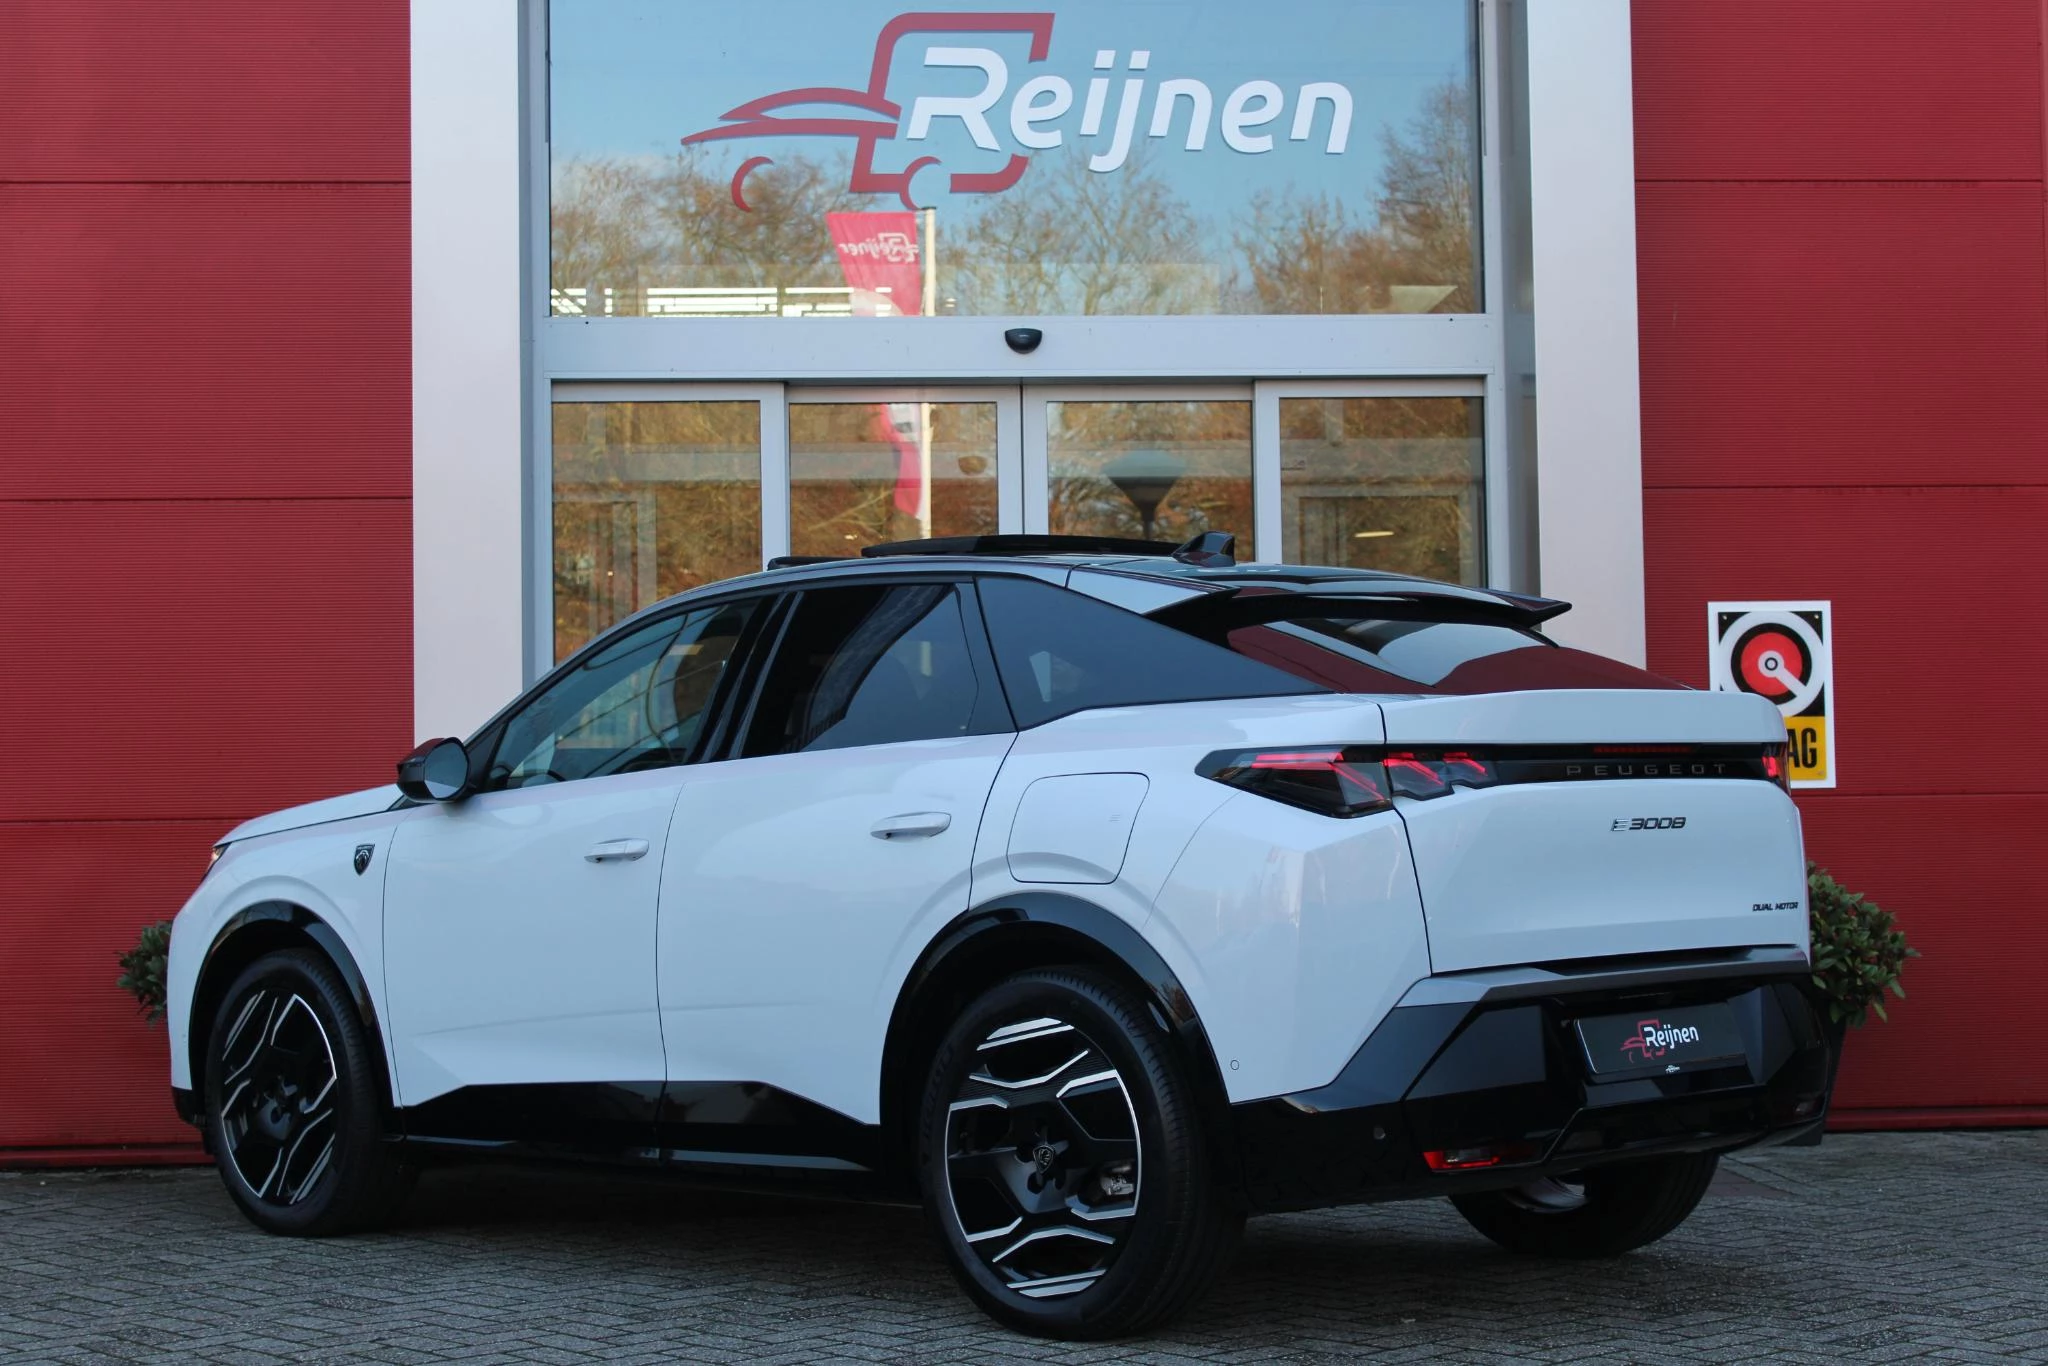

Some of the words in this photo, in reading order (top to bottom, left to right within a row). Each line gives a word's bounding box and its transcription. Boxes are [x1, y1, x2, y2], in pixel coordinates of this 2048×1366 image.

[907, 47, 1353, 172] Reijnen
[1787, 727, 1817, 769] AG
[1566, 763, 1726, 776] PEUGEOT
[1752, 903, 1773, 912] DUAL
[1775, 901, 1799, 910] MOTOR
[1643, 1024, 1699, 1049] Reijnen
